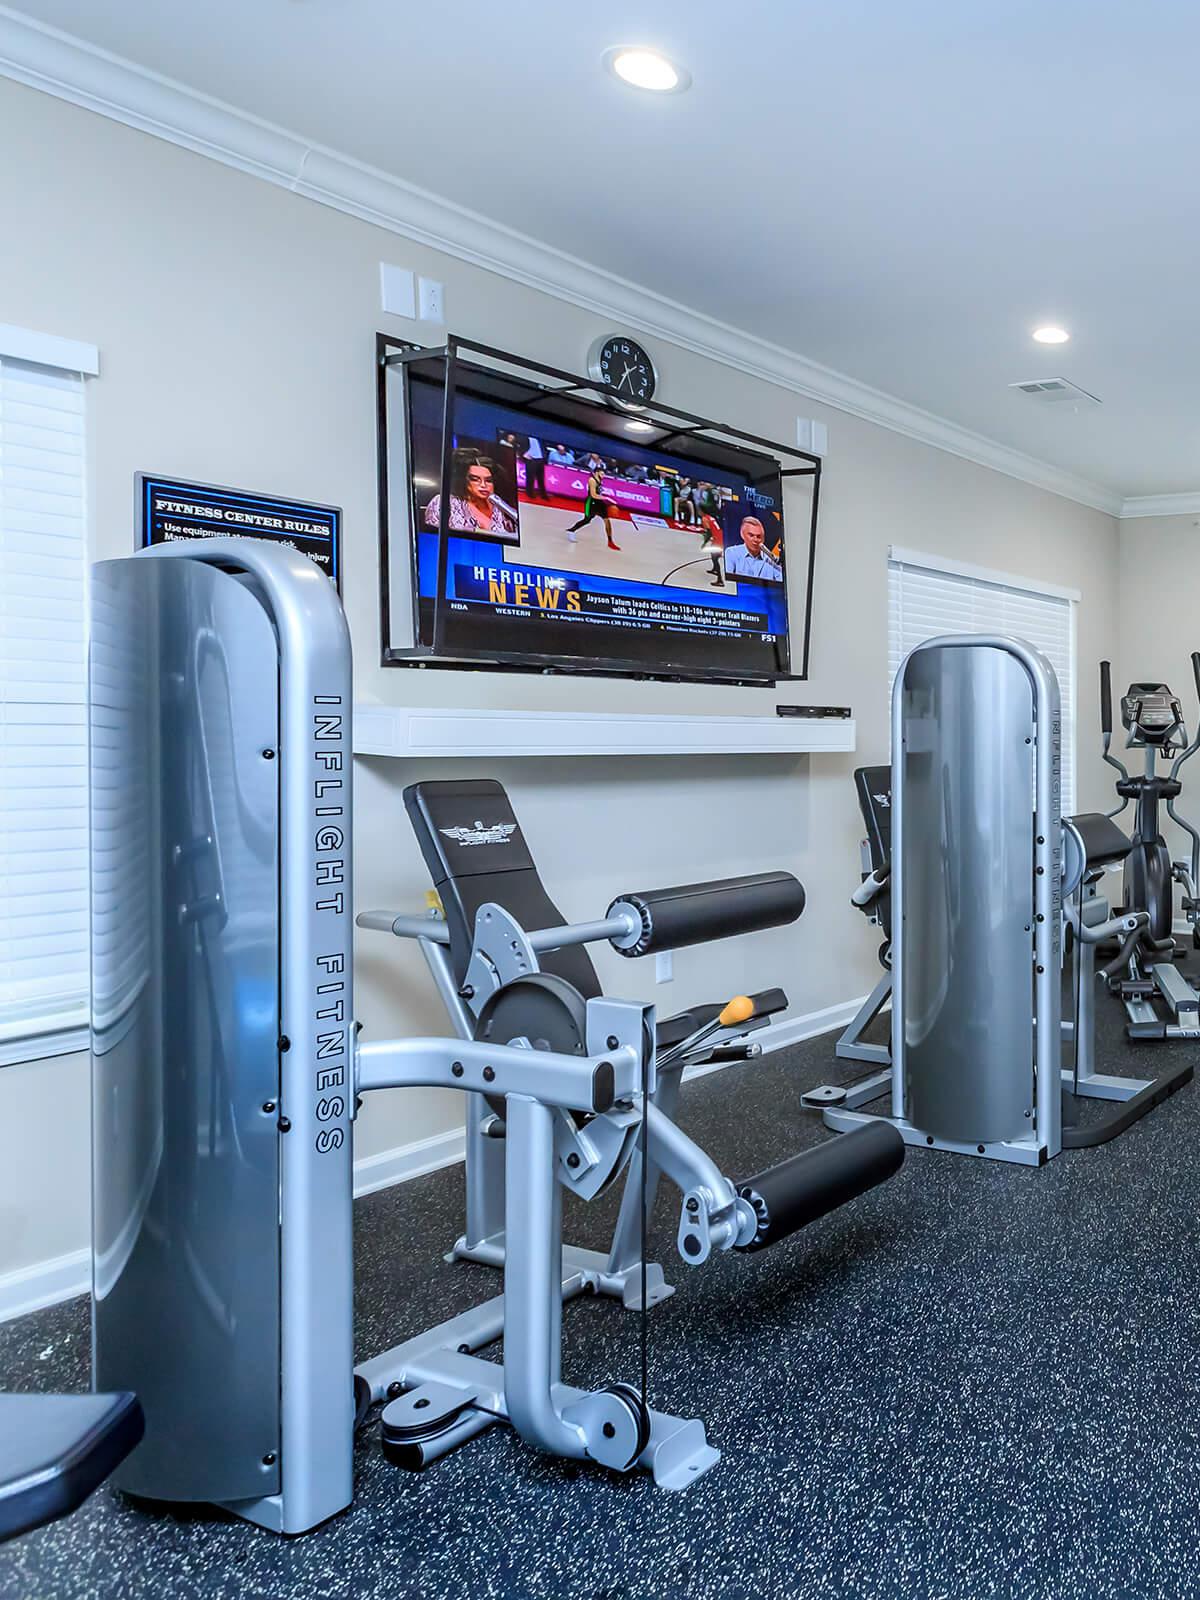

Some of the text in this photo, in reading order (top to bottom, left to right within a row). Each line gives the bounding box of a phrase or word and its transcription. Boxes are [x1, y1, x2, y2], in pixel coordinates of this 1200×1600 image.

[622, 344, 630, 355] 12
[601, 361, 608, 369] 9
[639, 365, 645, 374] 2
[156, 500, 330, 536] FITNESS CENTER RULES
[164, 522, 181, 532] Use
[183, 527, 230, 537] equipment
[474, 566, 566, 590] HERDLINE
[489, 581, 581, 612] NEWS
[586, 594, 609, 604] Jayson
[611, 597, 631, 606] Tatum
[632, 600, 649, 608] leads
[650, 602, 670, 611] Celtics
[496, 607, 530, 617] WESTERN
[761, 634, 776, 642] FS1
[314, 694, 345, 1154] INFLIGHT FITNESS
